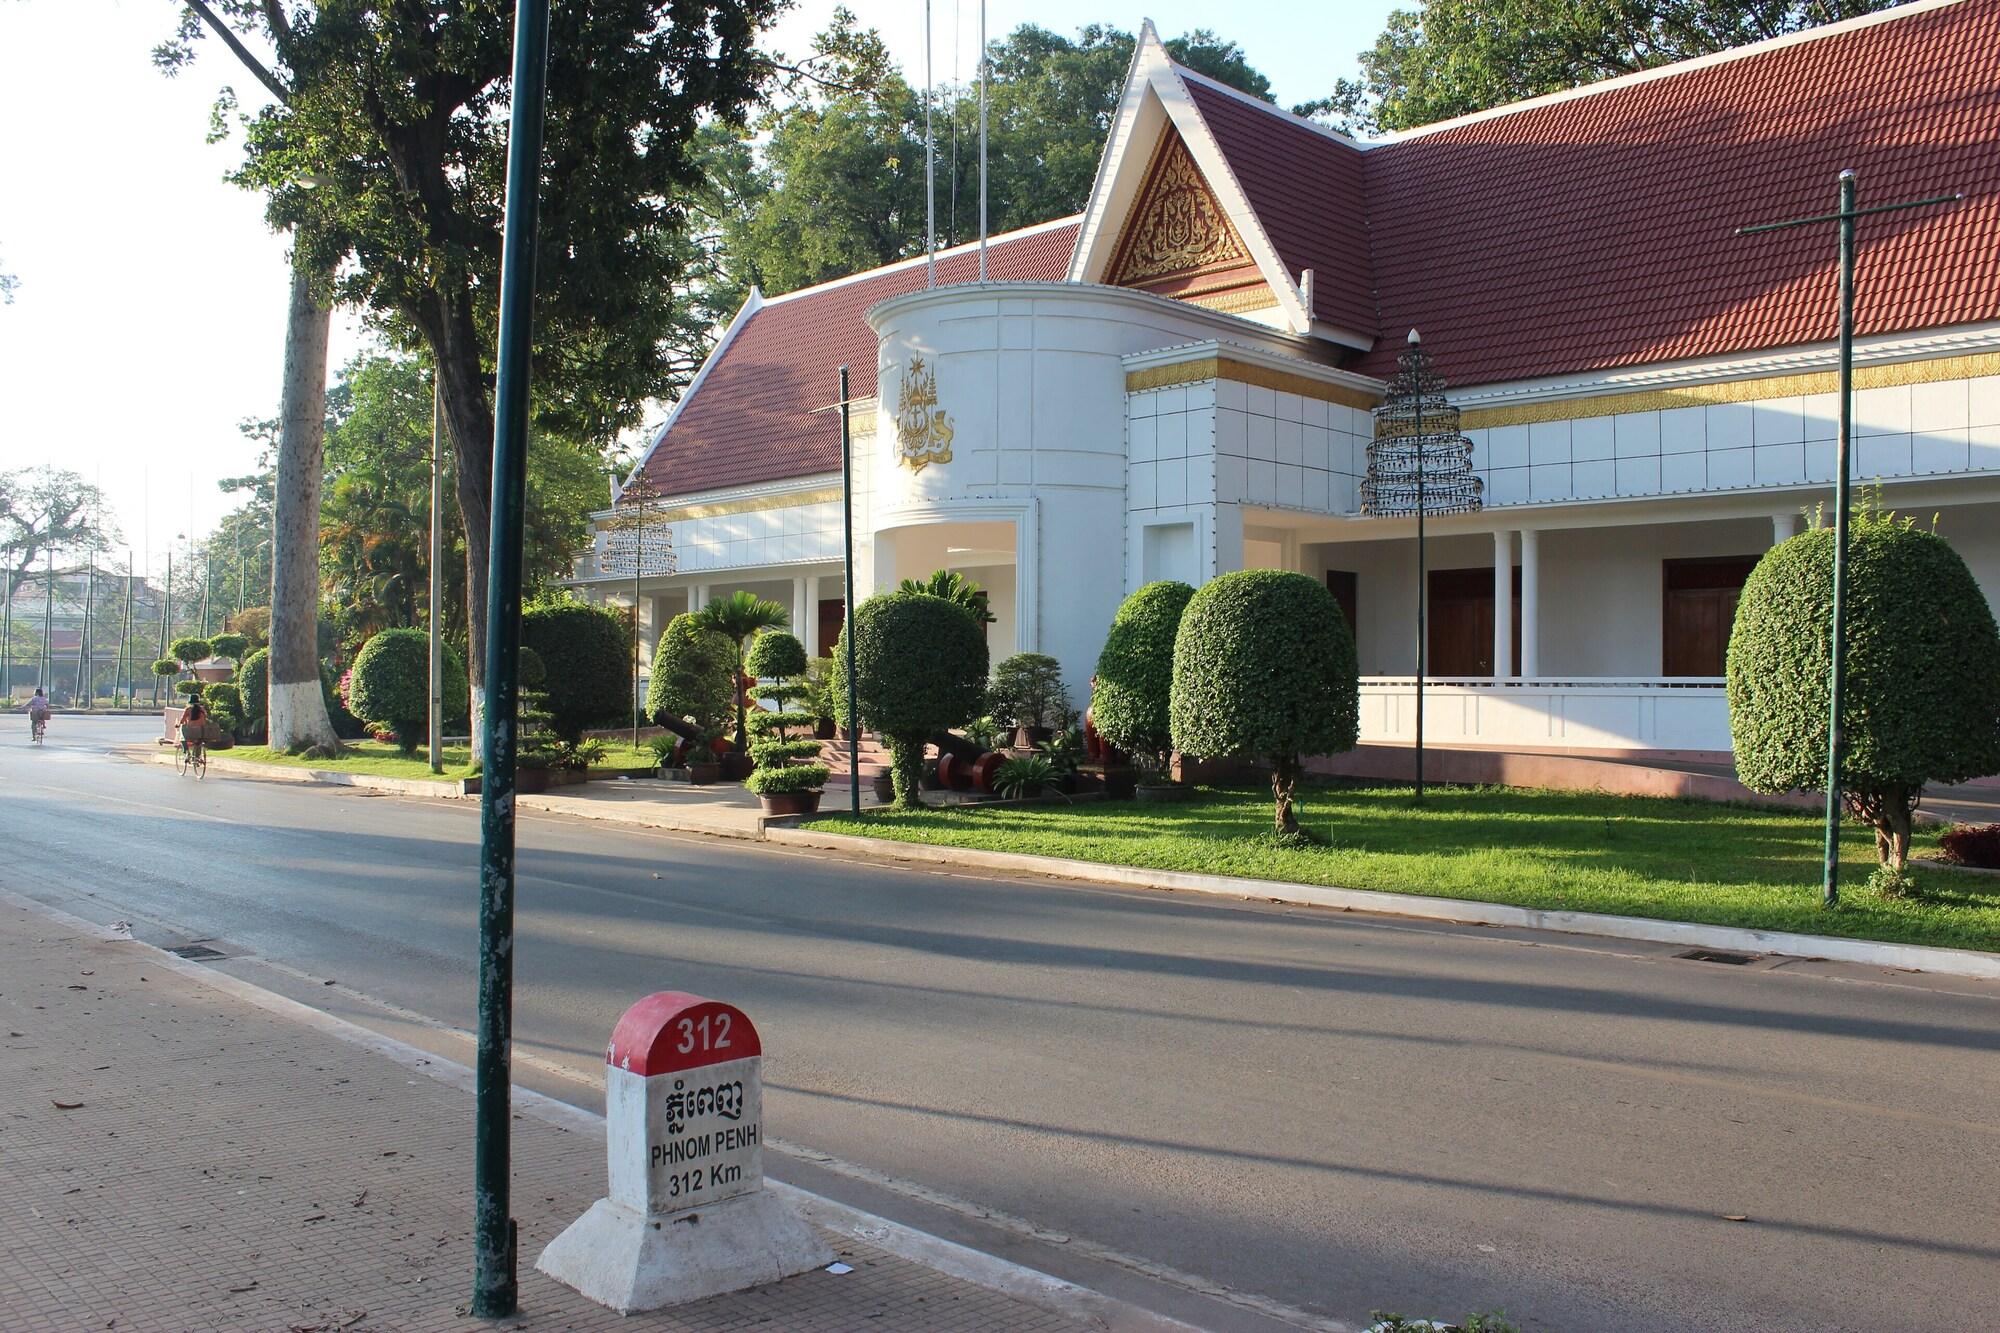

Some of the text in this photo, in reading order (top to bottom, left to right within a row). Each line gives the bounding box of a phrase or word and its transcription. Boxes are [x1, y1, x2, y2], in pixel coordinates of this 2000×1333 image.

[677, 1013, 731, 1054] 312
[666, 1079, 743, 1135] ភ្នំពេញ
[651, 1123, 757, 1169] PHNOM PENH
[670, 1163, 741, 1197] 312 Km
